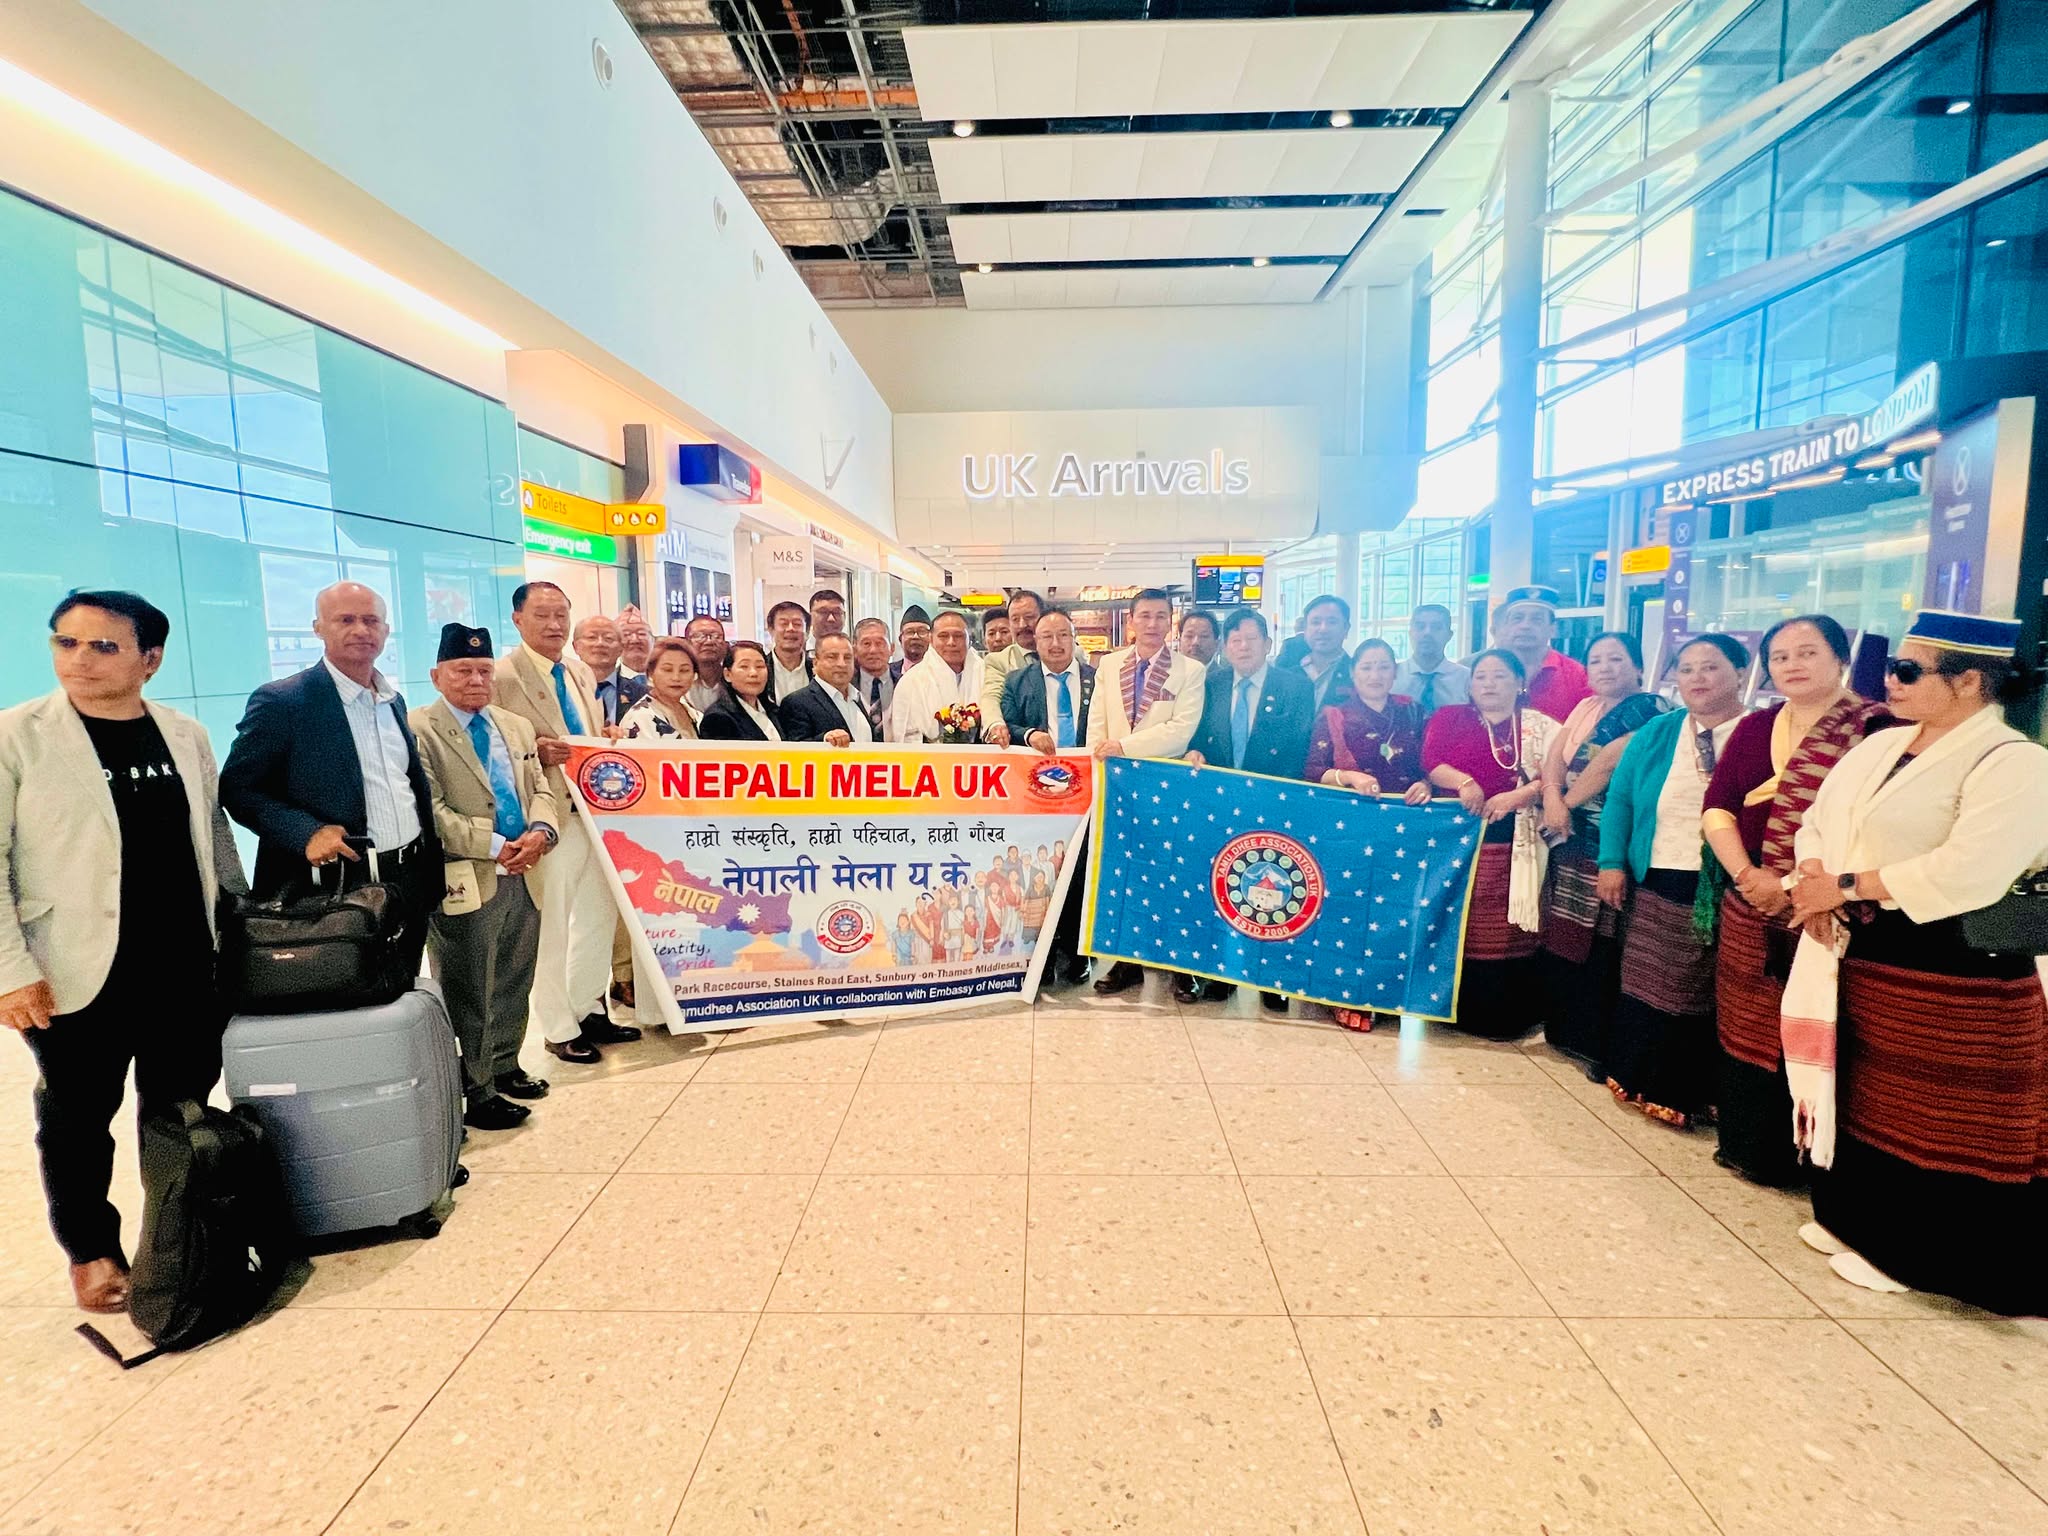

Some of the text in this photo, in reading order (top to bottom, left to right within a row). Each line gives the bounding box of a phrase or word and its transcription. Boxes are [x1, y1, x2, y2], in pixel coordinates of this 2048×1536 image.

[1663, 461, 1765, 504] EXPRESS
[1769, 434, 1832, 478] TRAIN
[1833, 422, 1860, 455] TO
[1862, 372, 1932, 443] LONDON
[963, 448, 1250, 498] UK Arrivals
[536, 493, 567, 515] Toilets
[525, 527, 593, 555] Emergency exit
[773, 550, 803, 562] M&S
[130, 763, 173, 779] BAK
[662, 763, 814, 798] NEPALI
[831, 764, 940, 798] MELA
[954, 765, 1008, 798] UK
[722, 854, 820, 895] नेपाली
[832, 855, 897, 892] मेला
[1217, 838, 1318, 897] TAMU DHEE ASSOCIATION UK
[654, 868, 724, 914] नेपाल
[1233, 915, 1290, 937] ESTD 2000
[654, 942, 711, 957] dentity,
[676, 957, 715, 970] Pride
[674, 983, 700, 995] Park
[703, 979, 771, 993] Racecourse,
[774, 975, 814, 987] Staines
[817, 975, 844, 986] Road
[847, 974, 872, 985] East,
[875, 972, 917, 983] Sunbury
[975, 961, 1023, 974] Middlesex,
[736, 997, 800, 1013] Association
[803, 994, 821, 1007] UK
[823, 994, 833, 1006] in
[836, 990, 903, 1005] collaboration
[905, 988, 927, 1000] with
[929, 984, 974, 998] Embassy
[976, 981, 988, 992] of
[987, 978, 1018, 991] Nepal,
